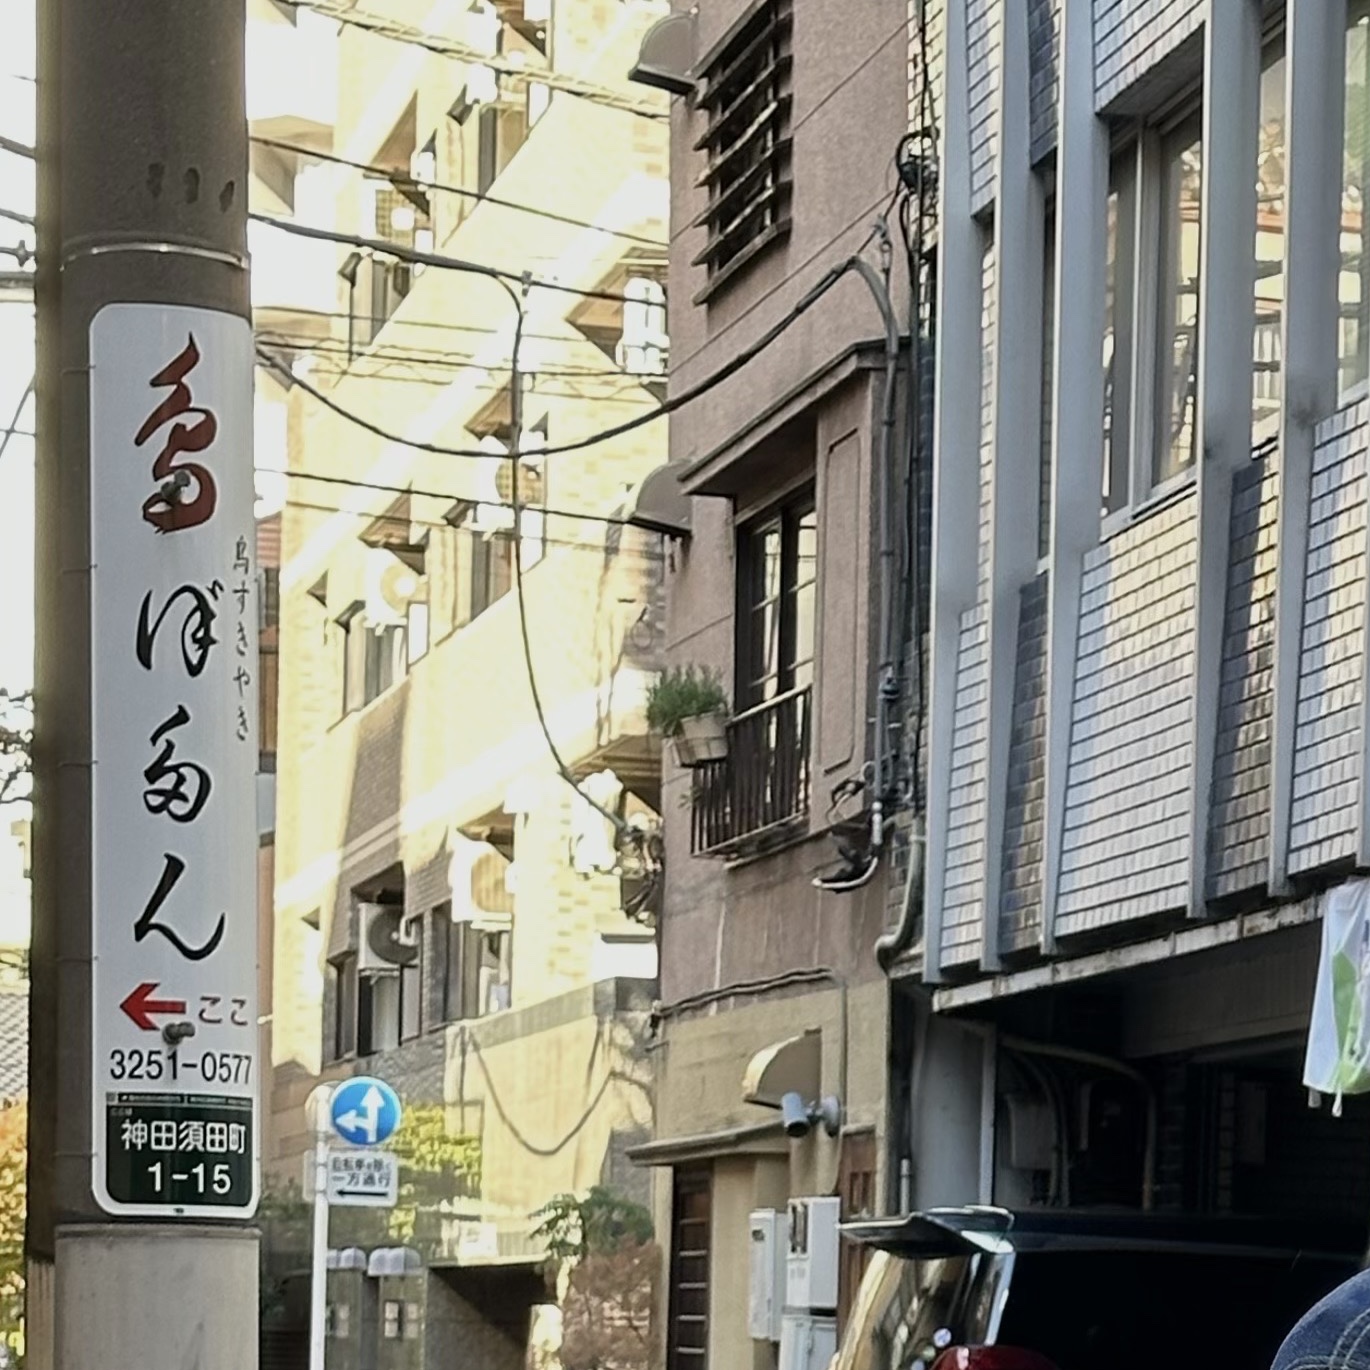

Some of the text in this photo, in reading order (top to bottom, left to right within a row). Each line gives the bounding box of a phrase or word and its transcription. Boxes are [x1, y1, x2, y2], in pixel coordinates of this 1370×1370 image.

[198, 996, 249, 1027] ここ
[109, 1049, 253, 1085] 3251-0577
[120, 1118, 247, 1154] 神田須田町
[147, 1161, 232, 1195] 1-15
